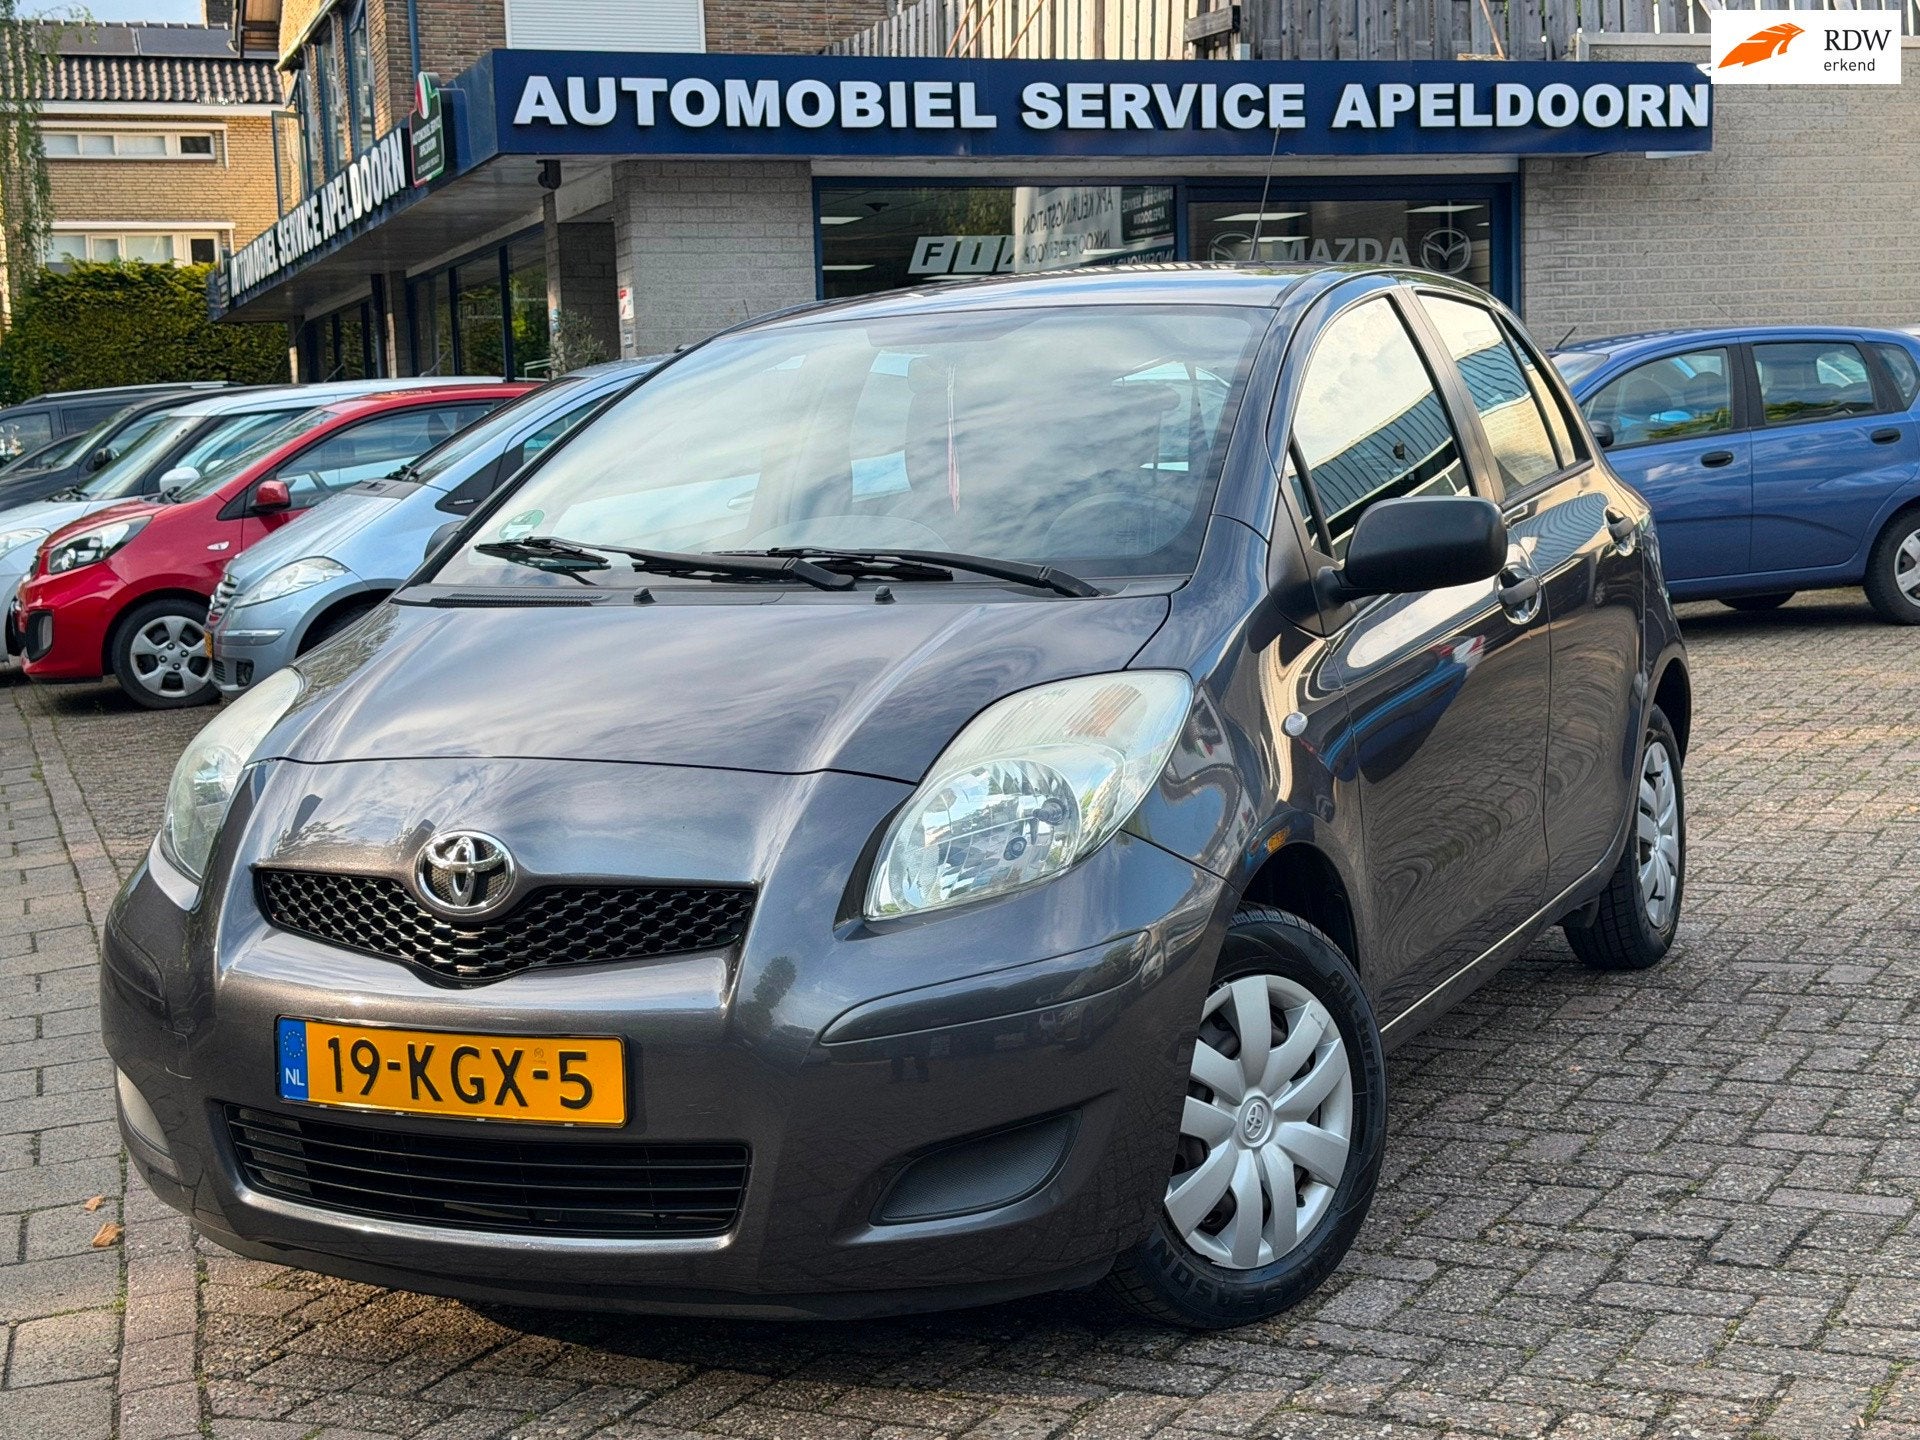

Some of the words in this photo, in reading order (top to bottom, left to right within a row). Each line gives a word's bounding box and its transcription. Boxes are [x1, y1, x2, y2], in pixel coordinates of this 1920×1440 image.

[513, 75, 997, 129] AUTOMOBIEL
[1021, 81, 1306, 131] SERVICE
[1331, 82, 1710, 129] APELDOORN
[231, 231, 279, 298] AUTOMOBIEL
[277, 194, 322, 267] SERVICE
[321, 127, 406, 241] APELDOORN
[1273, 237, 1411, 265] MAZDA
[285, 1069, 305, 1086] NL
[328, 1037, 593, 1110] 19-KGX-5
